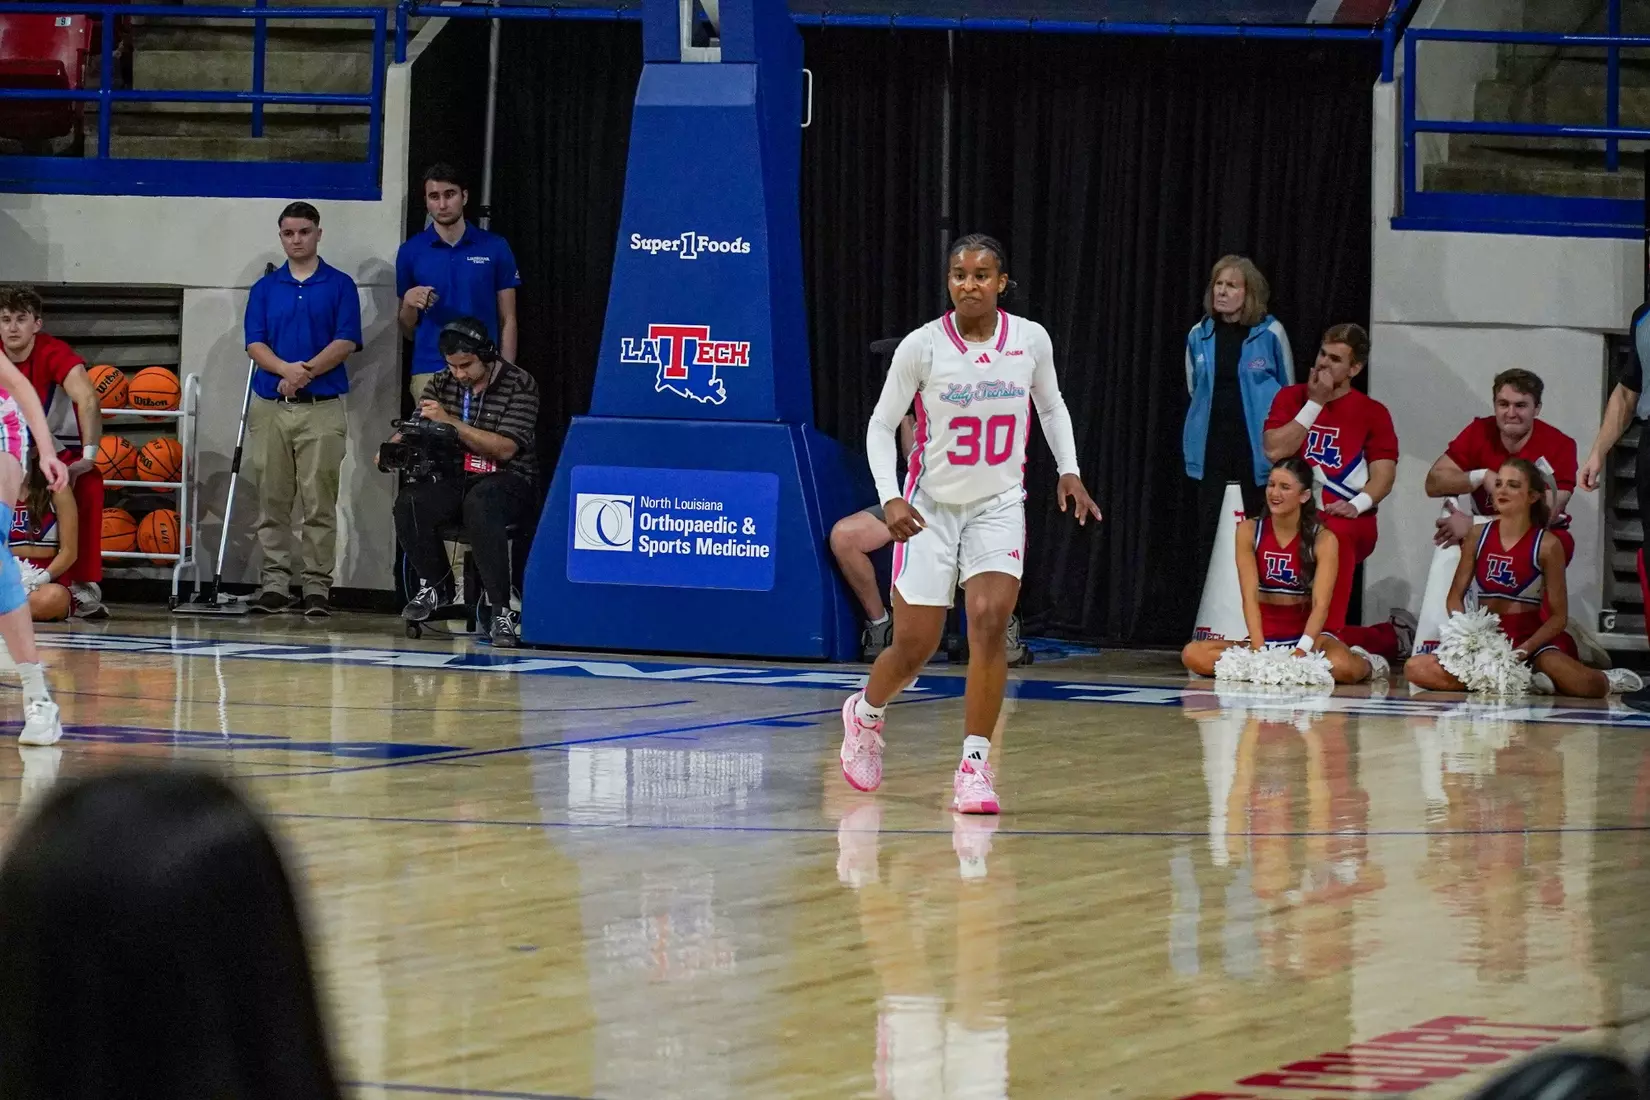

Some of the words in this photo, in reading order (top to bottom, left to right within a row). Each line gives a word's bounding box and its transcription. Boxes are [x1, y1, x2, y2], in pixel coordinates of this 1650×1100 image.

[630, 233, 680, 254] Super
[680, 231, 697, 259] 1
[697, 236, 750, 254] Foods
[620, 337, 660, 363] LA
[648, 323, 750, 379] TECH
[96, 369, 120, 394] Wilson
[134, 395, 168, 406] Wilson
[947, 414, 1016, 465] 30
[640, 496, 671, 509] North
[674, 498, 723, 511] Louisiana
[639, 513, 737, 536] Orthopaedic
[741, 517, 756, 535] &
[638, 535, 691, 557] Sports
[696, 538, 770, 558] Medicine
[1603, 614, 1615, 628] G
